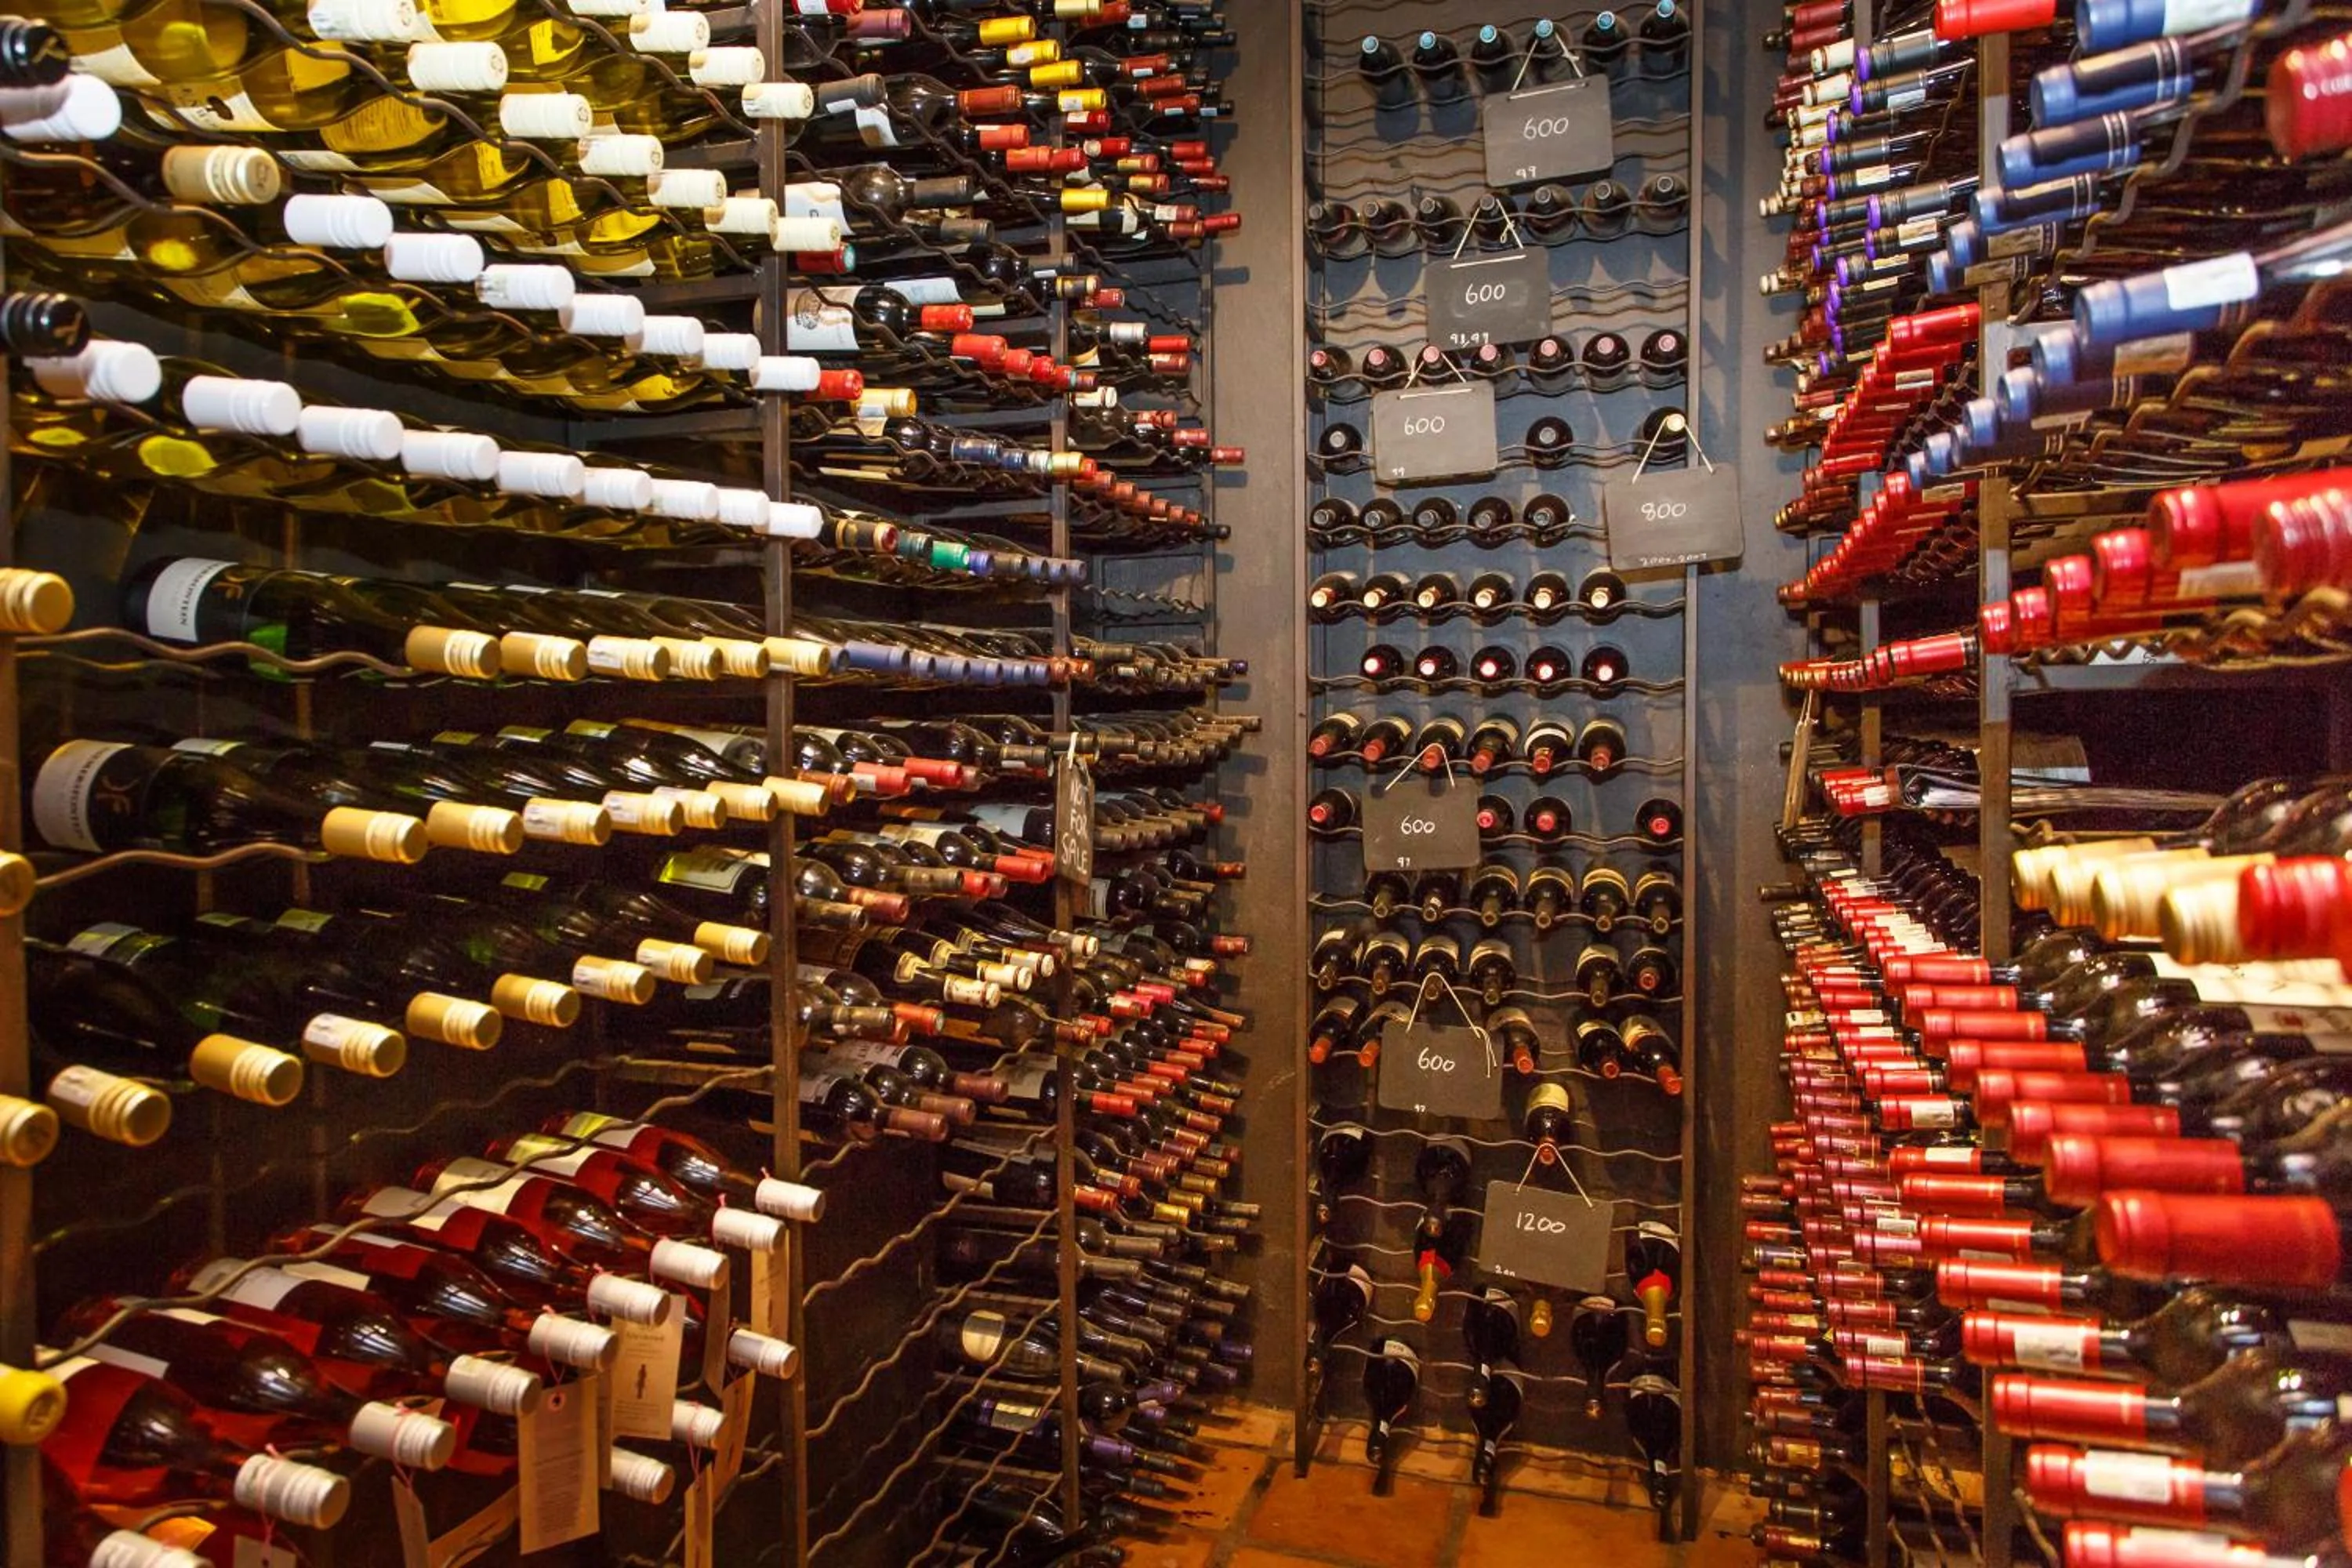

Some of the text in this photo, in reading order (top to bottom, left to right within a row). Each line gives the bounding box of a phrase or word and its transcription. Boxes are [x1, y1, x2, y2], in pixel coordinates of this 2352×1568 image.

[1523, 117, 1569, 140] 600
[1465, 283, 1506, 305] 600
[1404, 416, 1445, 435] 600
[1641, 503, 1686, 521] 800
[1070, 808, 1088, 840] FOR
[1401, 815, 1436, 835] 600
[1061, 832, 1088, 875] SALE
[1417, 1047, 1456, 1072] 600
[1515, 1211, 1566, 1233] 1200
